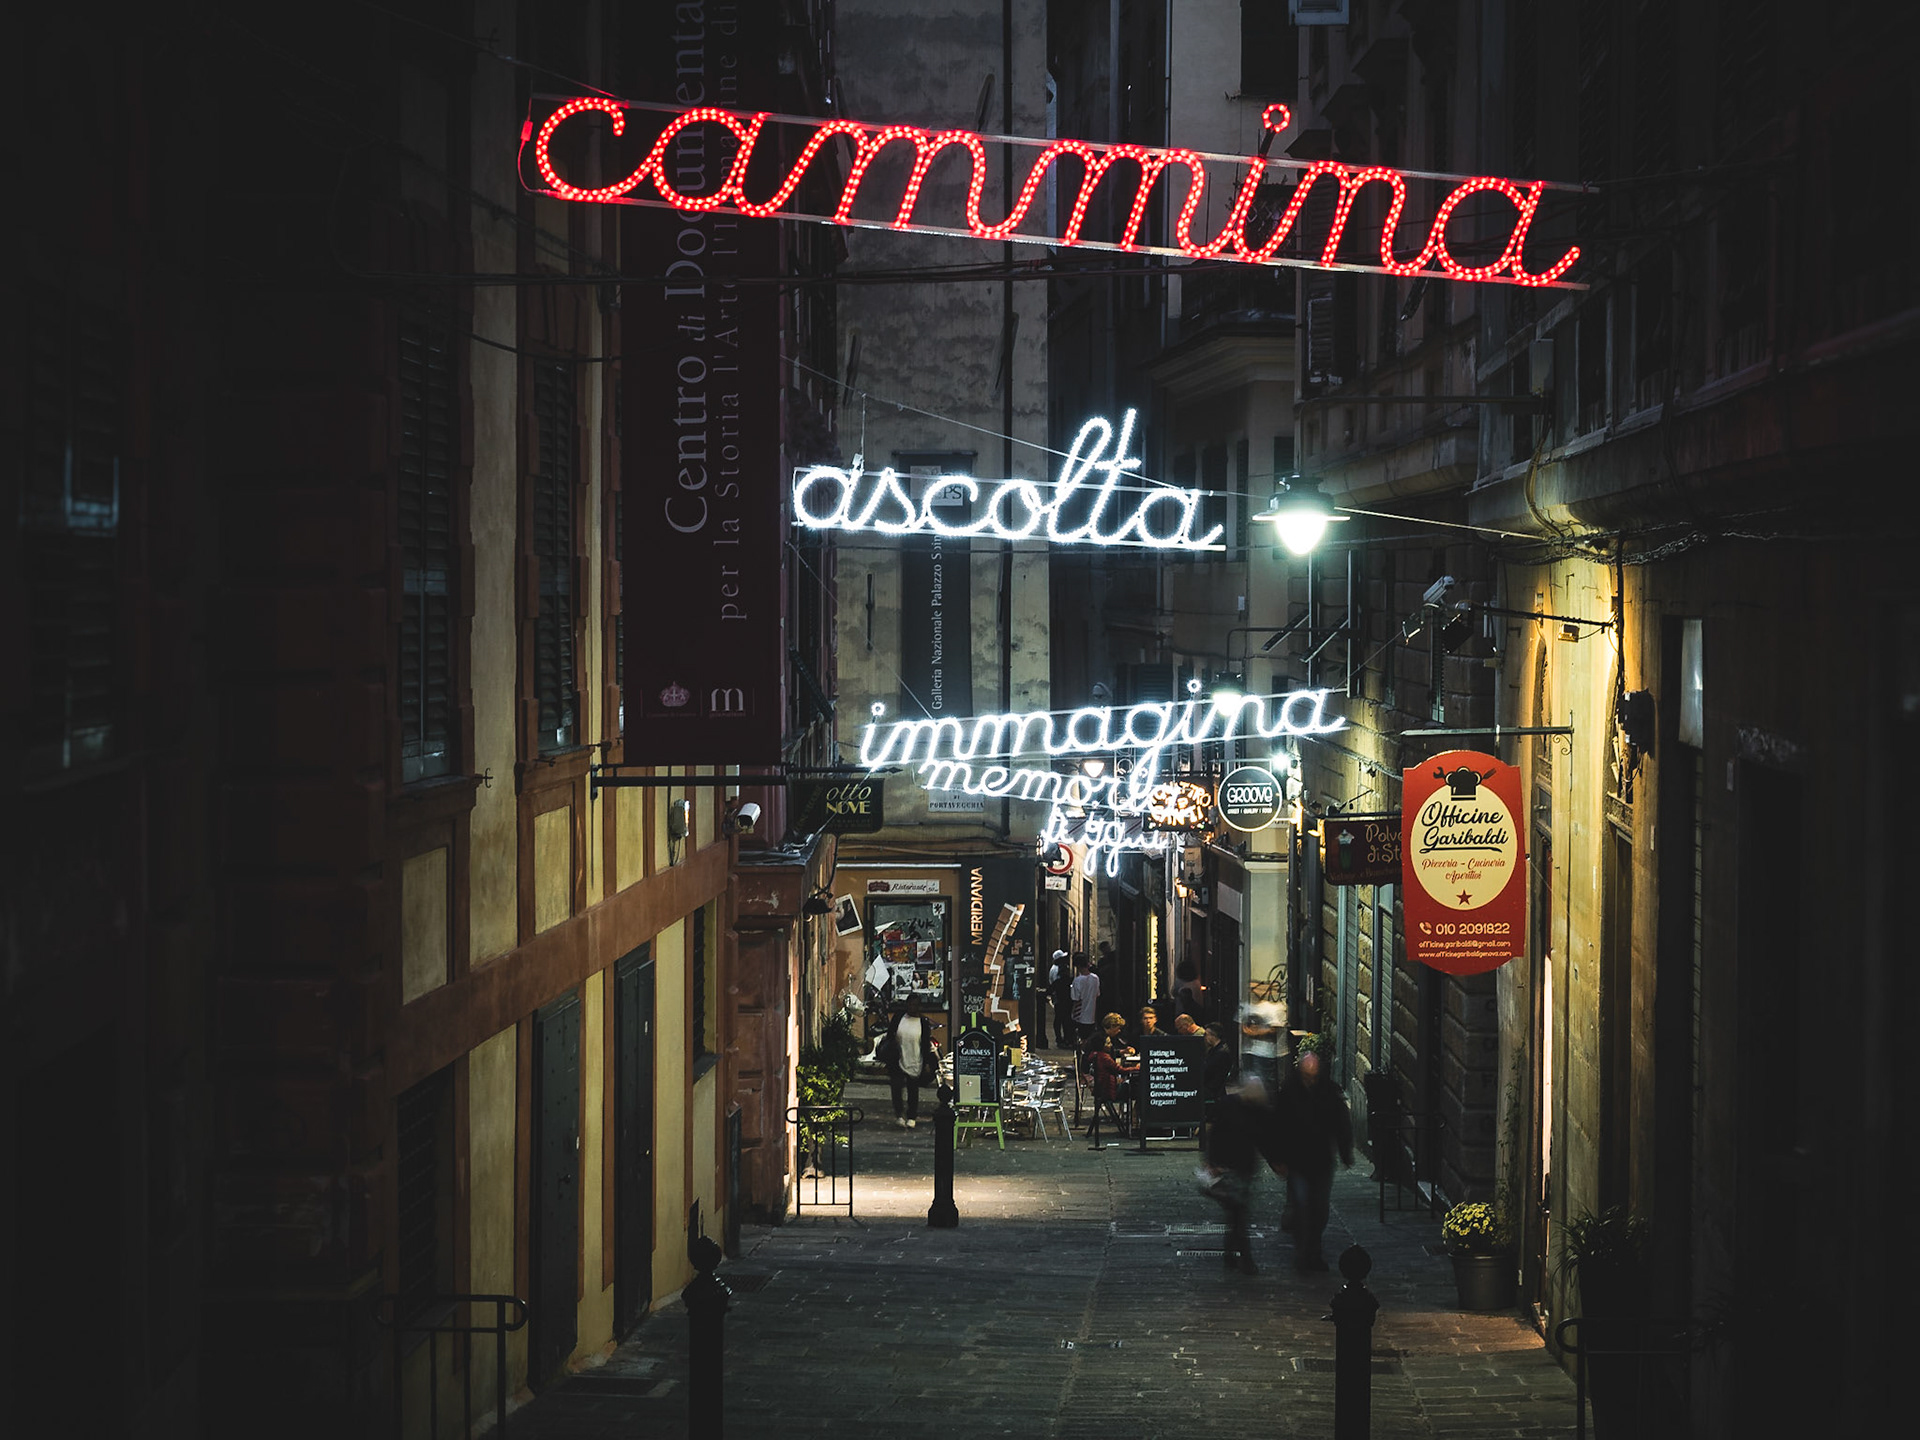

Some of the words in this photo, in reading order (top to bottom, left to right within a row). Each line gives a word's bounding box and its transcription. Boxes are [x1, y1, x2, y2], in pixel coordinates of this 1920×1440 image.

[535, 96, 1583, 288] cammina
[677, 314, 706, 342] di
[664, 355, 708, 533] Centro
[713, 392, 740, 499] Storia
[793, 409, 1224, 549] ascolta
[713, 518, 740, 546] la
[718, 564, 747, 621] per
[930, 564, 944, 607] Palazzo
[930, 611, 944, 665] Nazionale
[930, 668, 944, 710] Galleria
[861, 680, 1346, 800] immagina
[826, 783, 872, 801] otto
[826, 801, 871, 815] NOVE
[1421, 801, 1503, 826] Officine
[1423, 827, 1509, 849] Garibaldi
[1421, 858, 1458, 870] Pizzeria
[969, 866, 984, 945] MERIDIANA
[1435, 923, 1456, 935] 010
[1459, 922, 1510, 935] 2091822
[960, 1047, 991, 1056] GUINNESS
[1149, 1050, 1170, 1058] Eating
[1149, 1066, 1169, 1074] Eating
